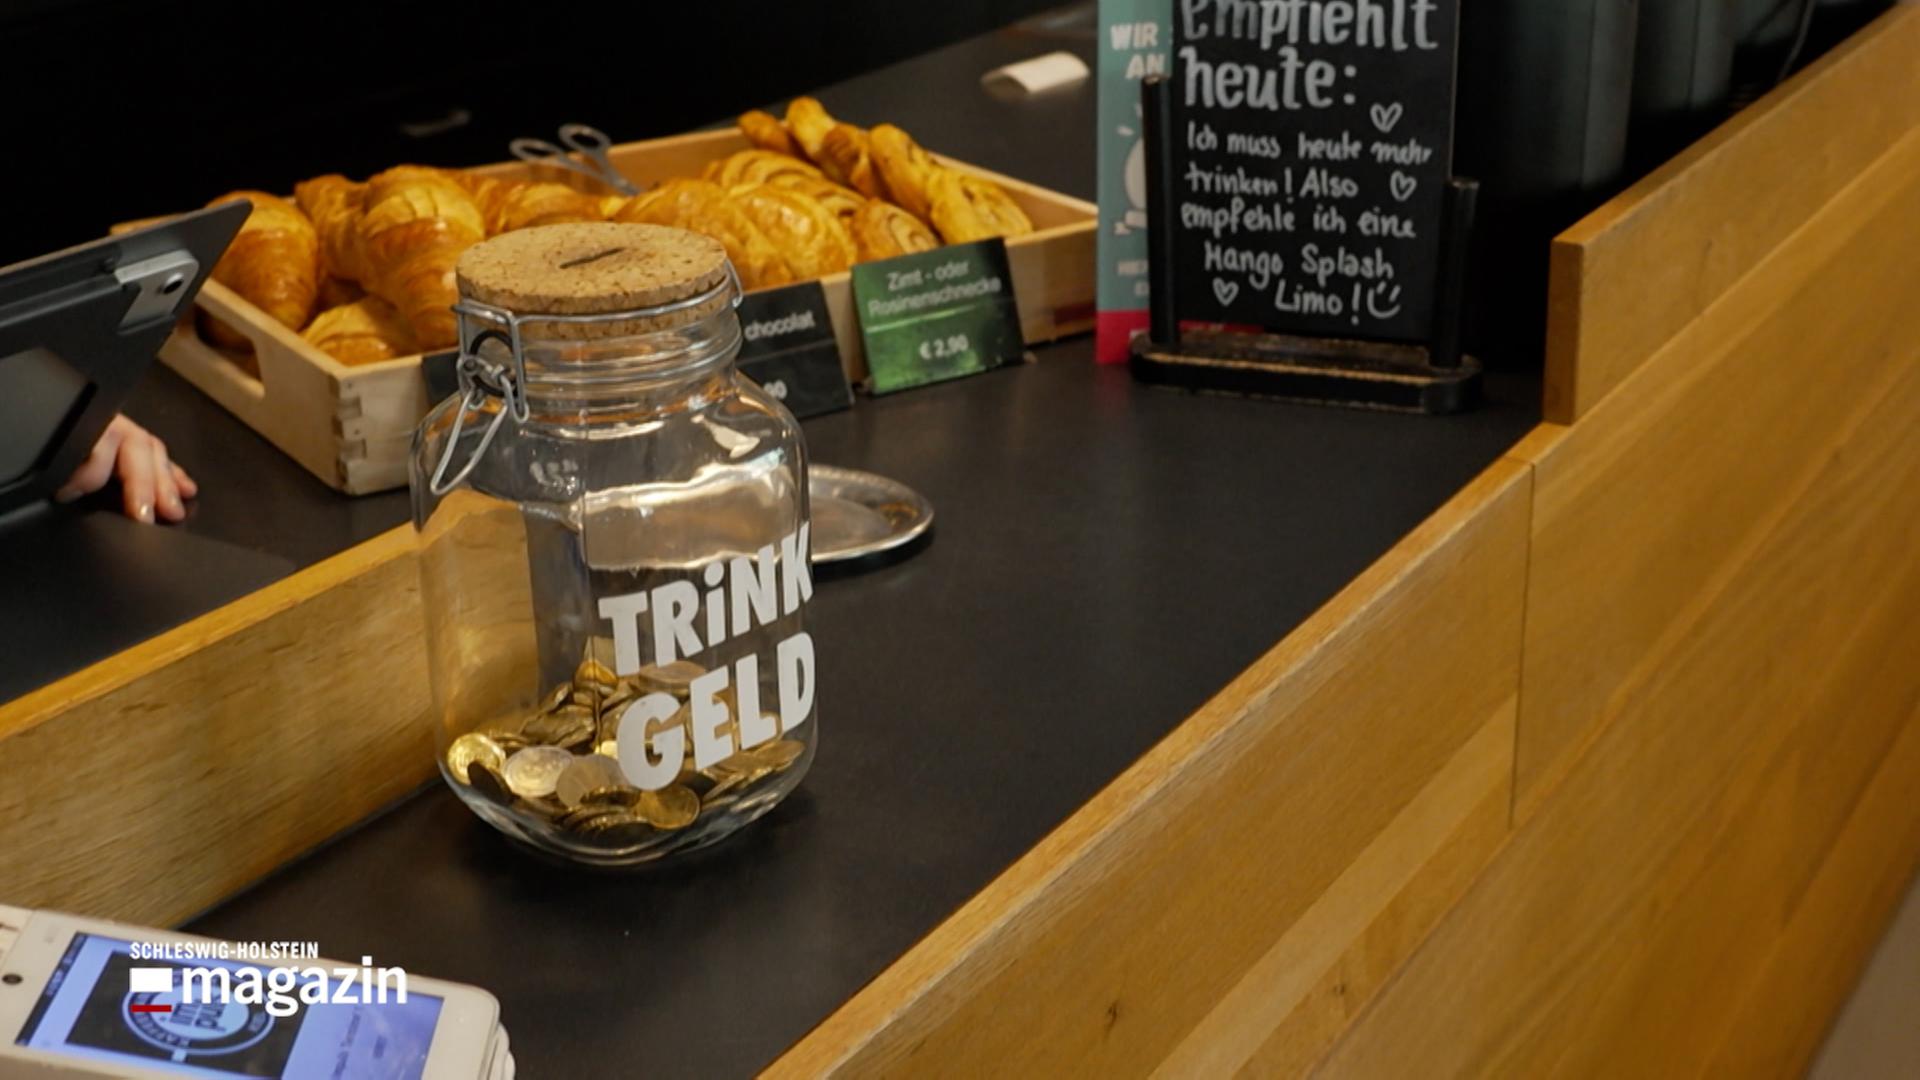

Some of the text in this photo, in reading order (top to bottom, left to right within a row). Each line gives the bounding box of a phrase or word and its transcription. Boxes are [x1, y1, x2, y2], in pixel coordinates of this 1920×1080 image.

[1110, 22, 1158, 50] WIR
[1182, 0, 1438, 51] empfiehlt
[1179, 46, 1357, 109] heute:
[1187, 120, 1433, 166] Ich muss heute mehr
[1299, 167, 1359, 199] Also
[1181, 196, 1416, 239] empfehle ich eine
[887, 269, 924, 291] Zimt
[934, 261, 970, 281] oder
[1301, 243, 1394, 287] Splash
[867, 276, 1003, 317] Rosinenschnecke
[744, 310, 816, 342] chocolat
[616, 632, 816, 791] GELD
